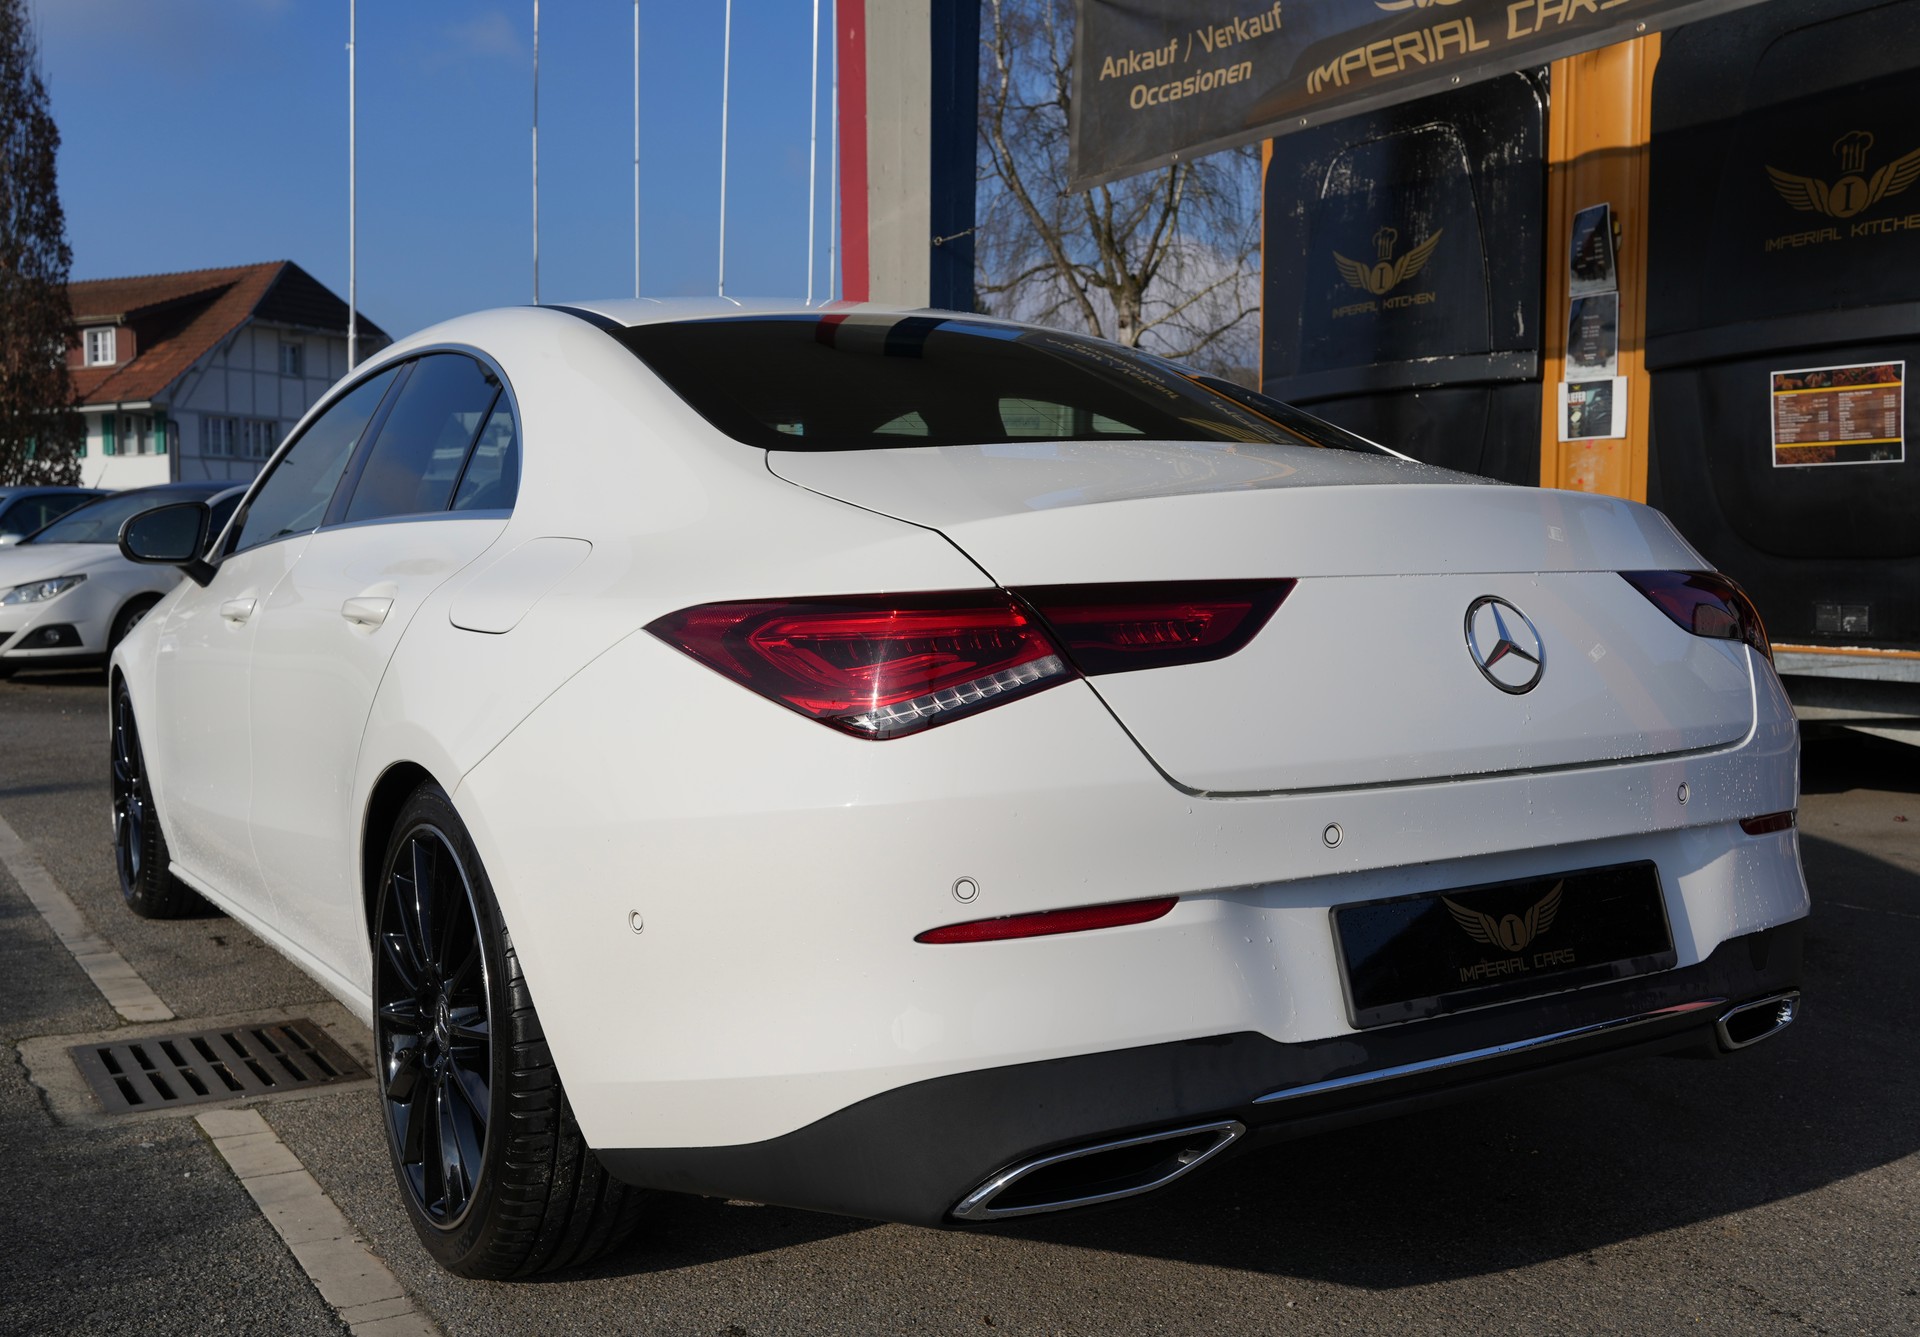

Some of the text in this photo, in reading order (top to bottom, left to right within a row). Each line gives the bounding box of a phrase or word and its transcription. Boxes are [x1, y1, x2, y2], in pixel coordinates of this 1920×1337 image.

[1099, 38, 1178, 81] Ankauf
[1196, 1, 1282, 53] Verkauf
[1307, 0, 1630, 94] IMPERIAL CAR
[1130, 61, 1252, 110] Occasionen
[1765, 228, 1842, 252] IMPERIAL
[1332, 292, 1436, 319] IMPERIAL KITCHEN
[1459, 948, 1576, 982] IMPERIAL CARS
